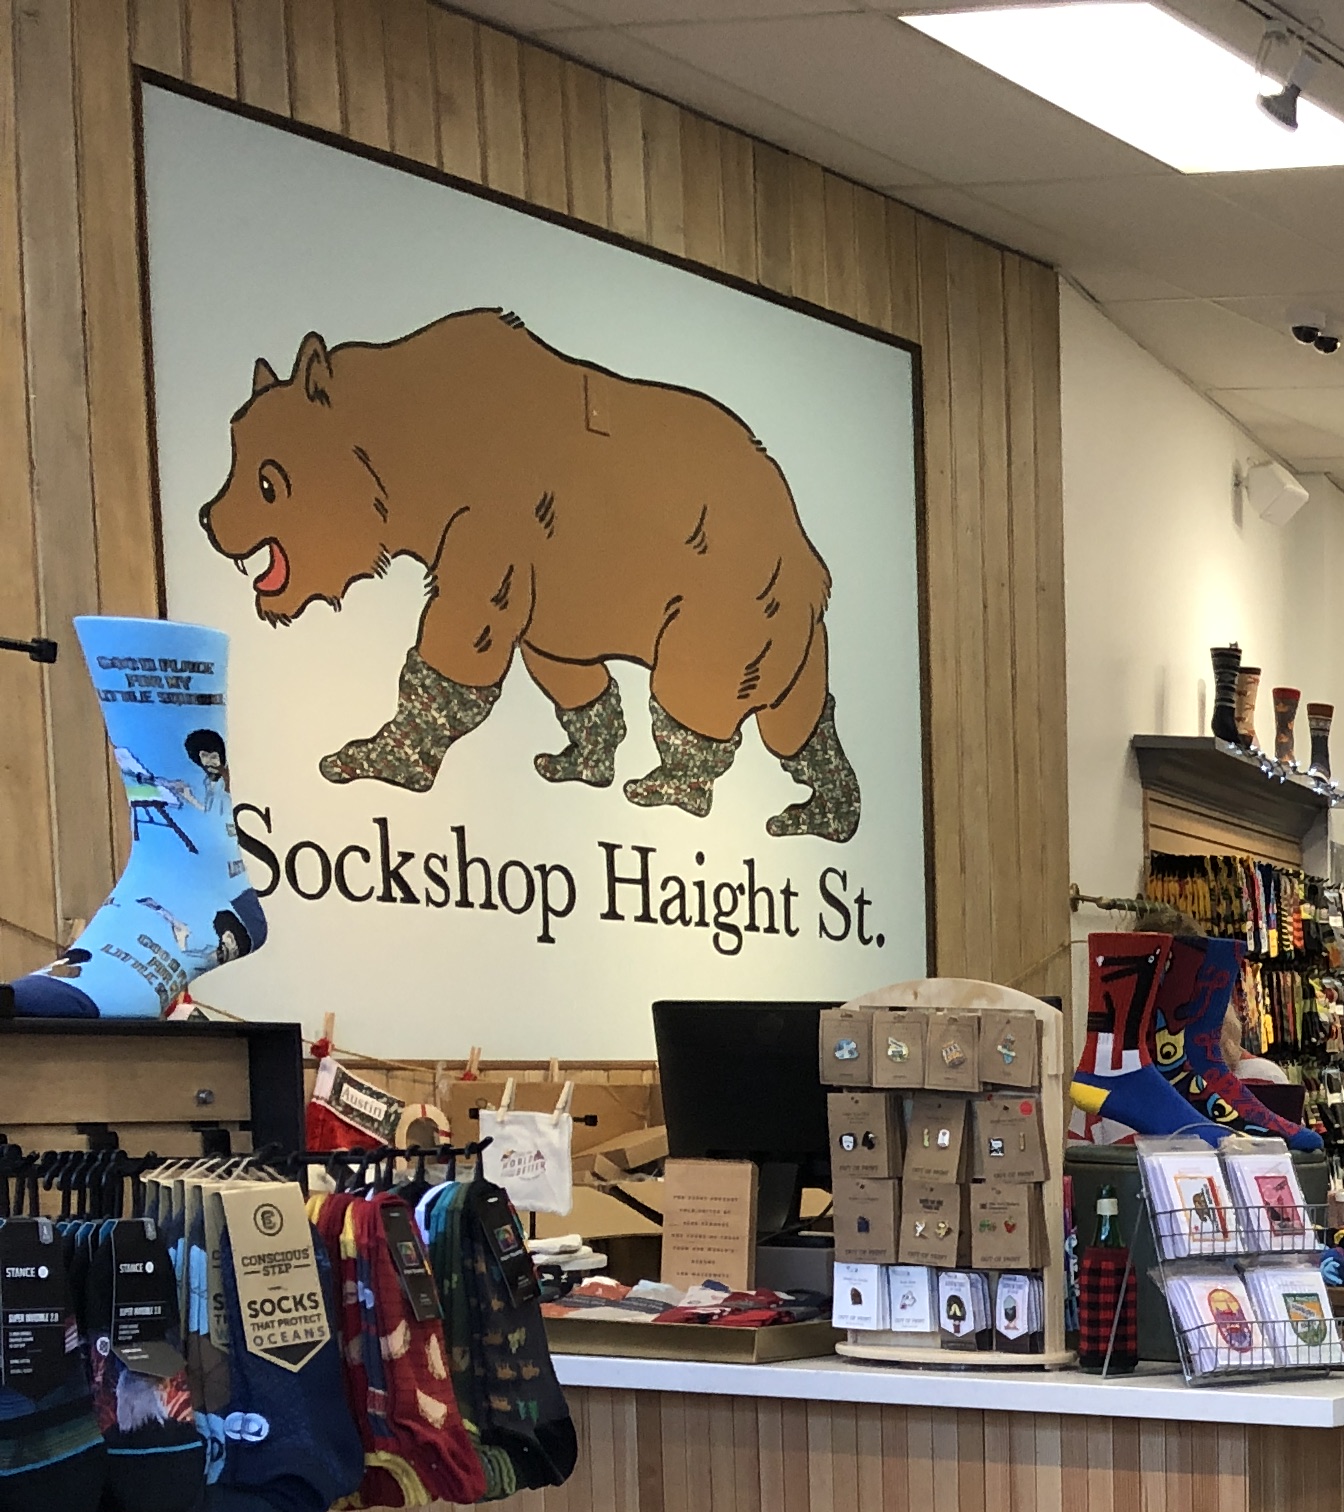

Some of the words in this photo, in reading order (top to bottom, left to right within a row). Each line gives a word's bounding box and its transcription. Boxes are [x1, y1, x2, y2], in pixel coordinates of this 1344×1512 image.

[234, 802, 576, 944] Sockshop
[598, 841, 800, 956] Haight
[818, 867, 886, 948] St.
[341, 1085, 384, 1119] Austin
[241, 1248, 310, 1268] CONSCIOUS
[6, 1268, 35, 1278] STANCE
[262, 1263, 292, 1277] STEP
[247, 1292, 320, 1318] SOCKS
[251, 1319, 275, 1332] THAT
[277, 1313, 322, 1329] PROTECT
[253, 1326, 326, 1347] OCEANS
